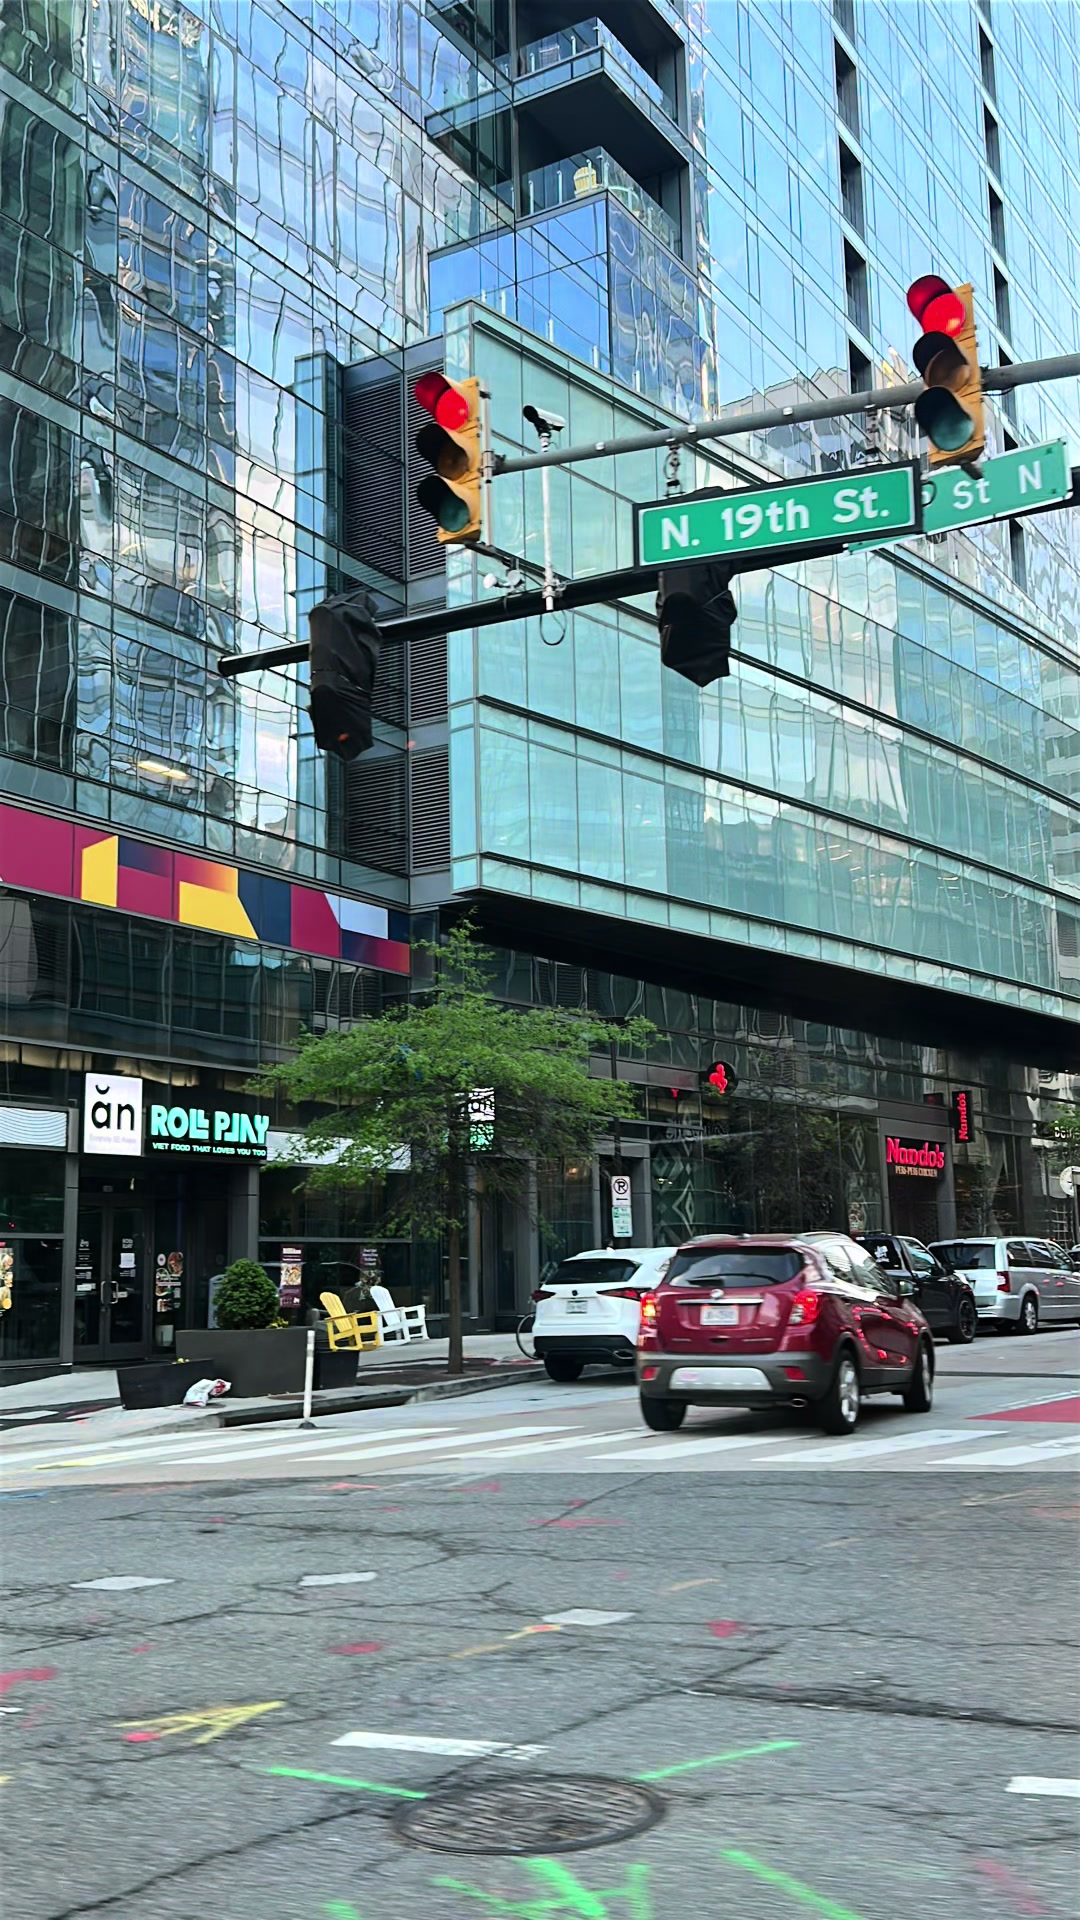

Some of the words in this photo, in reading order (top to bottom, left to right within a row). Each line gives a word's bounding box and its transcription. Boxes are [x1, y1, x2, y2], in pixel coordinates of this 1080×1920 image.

[953, 478, 990, 511] St
[1018, 460, 1042, 494] N
[660, 515, 700, 551] N.
[722, 498, 809, 541] 19th
[832, 487, 890, 524] St.
[151, 1105, 209, 1140] ROLL
[956, 1093, 969, 1140] Nando's
[152, 1142, 169, 1150] VIET
[171, 1143, 190, 1152] FOOD
[192, 1145, 211, 1153] THAT
[212, 1146, 235, 1155] LOVES
[236, 1148, 251, 1156] YOU
[252, 1149, 266, 1157] TOO
[886, 1137, 945, 1169] Nando's
